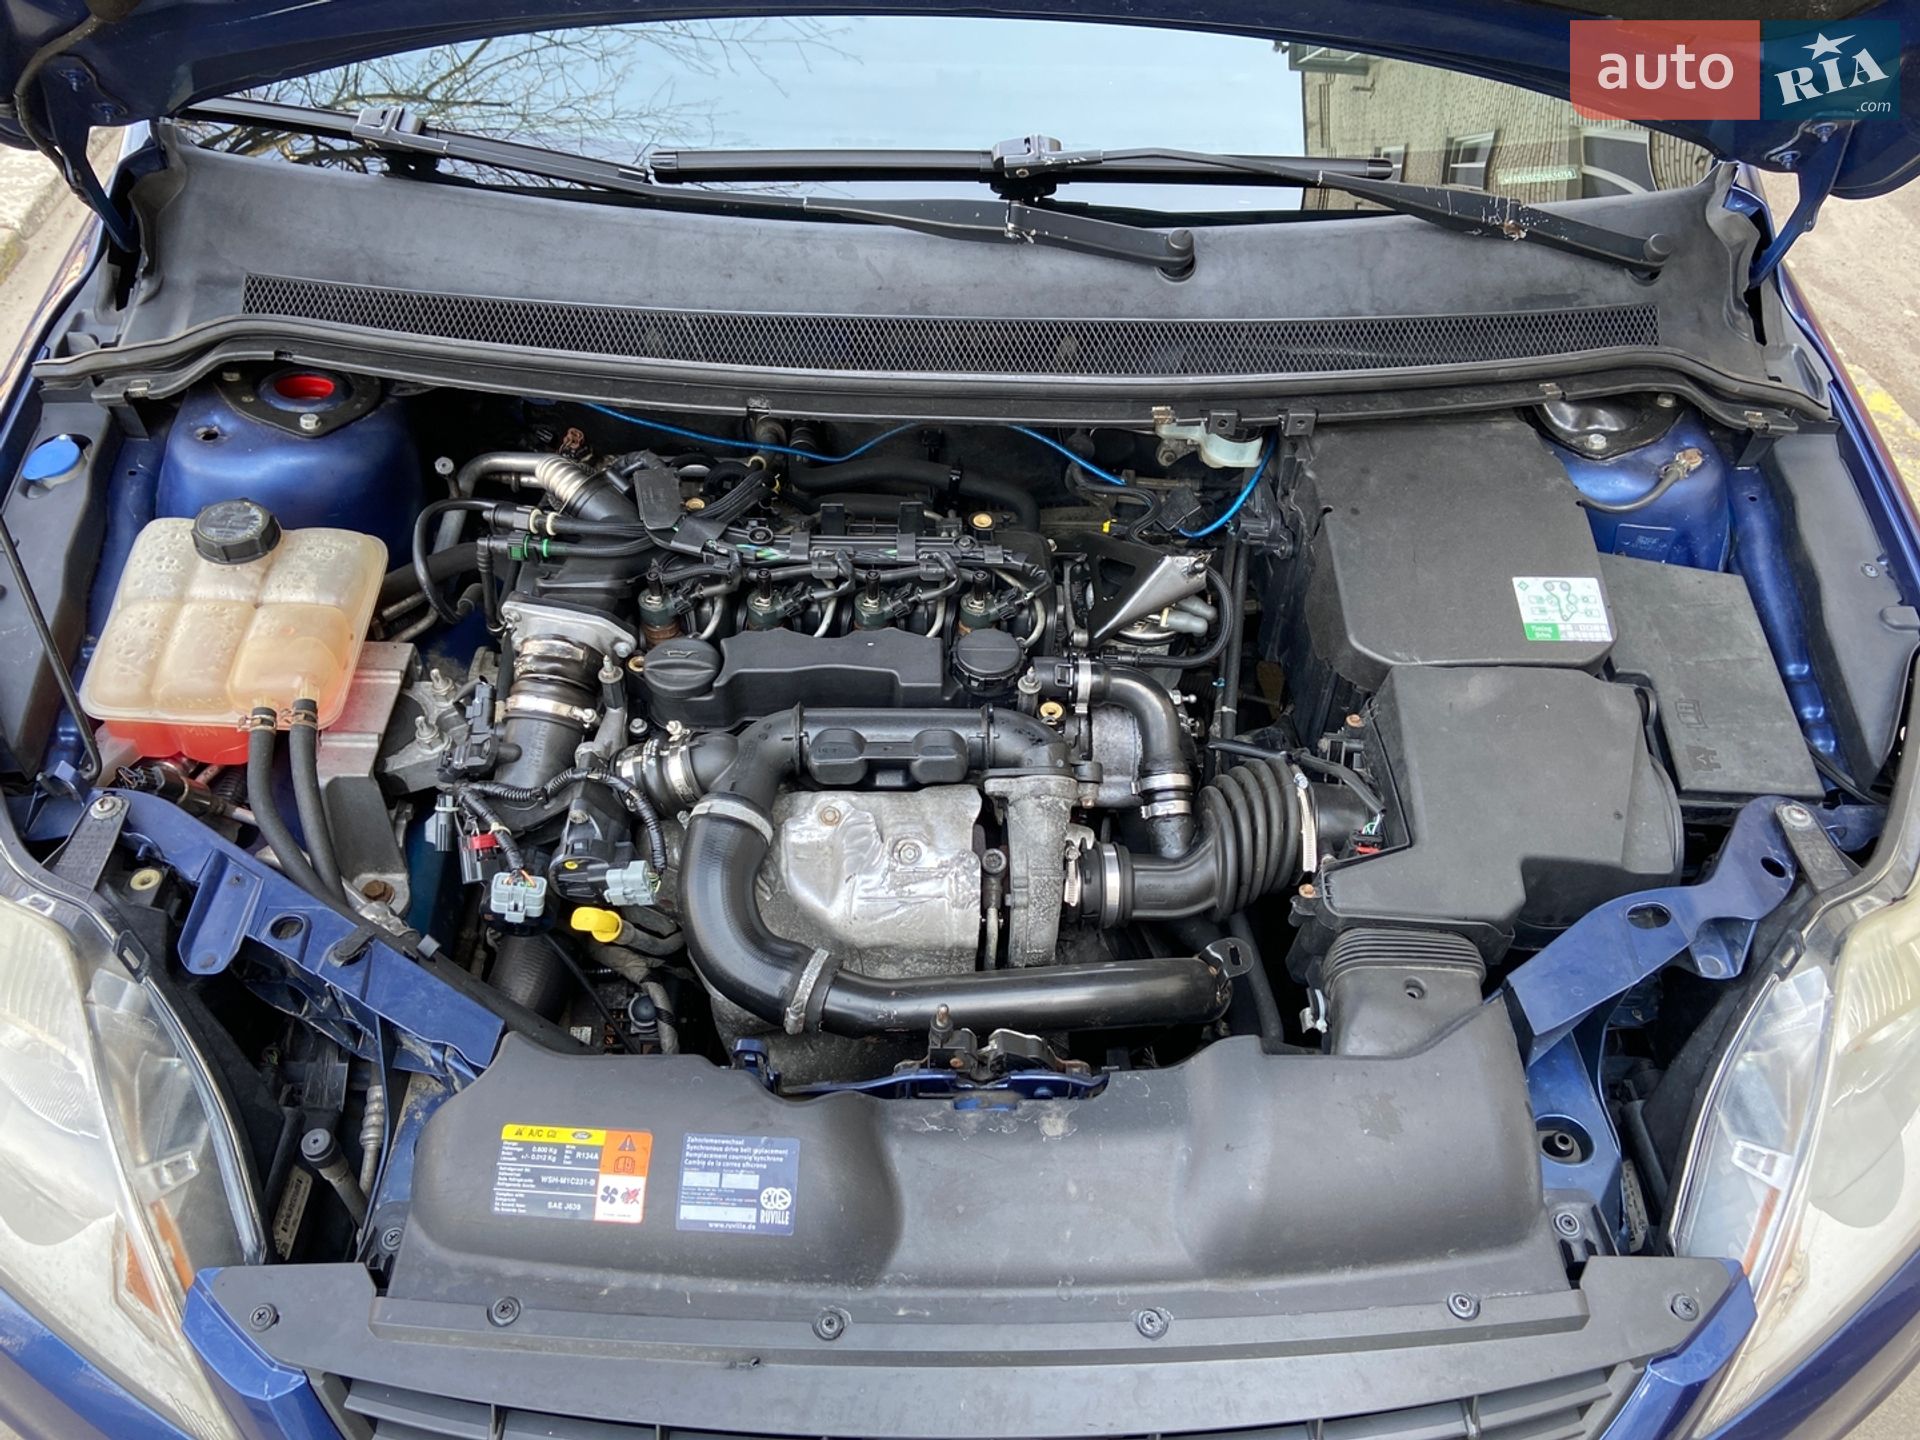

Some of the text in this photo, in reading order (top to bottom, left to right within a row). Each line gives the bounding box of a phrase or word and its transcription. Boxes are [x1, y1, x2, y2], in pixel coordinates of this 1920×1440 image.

[528, 1129, 544, 1138] A/C
[724, 1145, 739, 1153] drive
[740, 1146, 752, 1154] belt
[575, 1151, 599, 1160] R134A
[547, 1201, 563, 1210] SAE
[760, 1209, 790, 1225] RUVILLE
[708, 1221, 756, 1230] www.ruville.de
